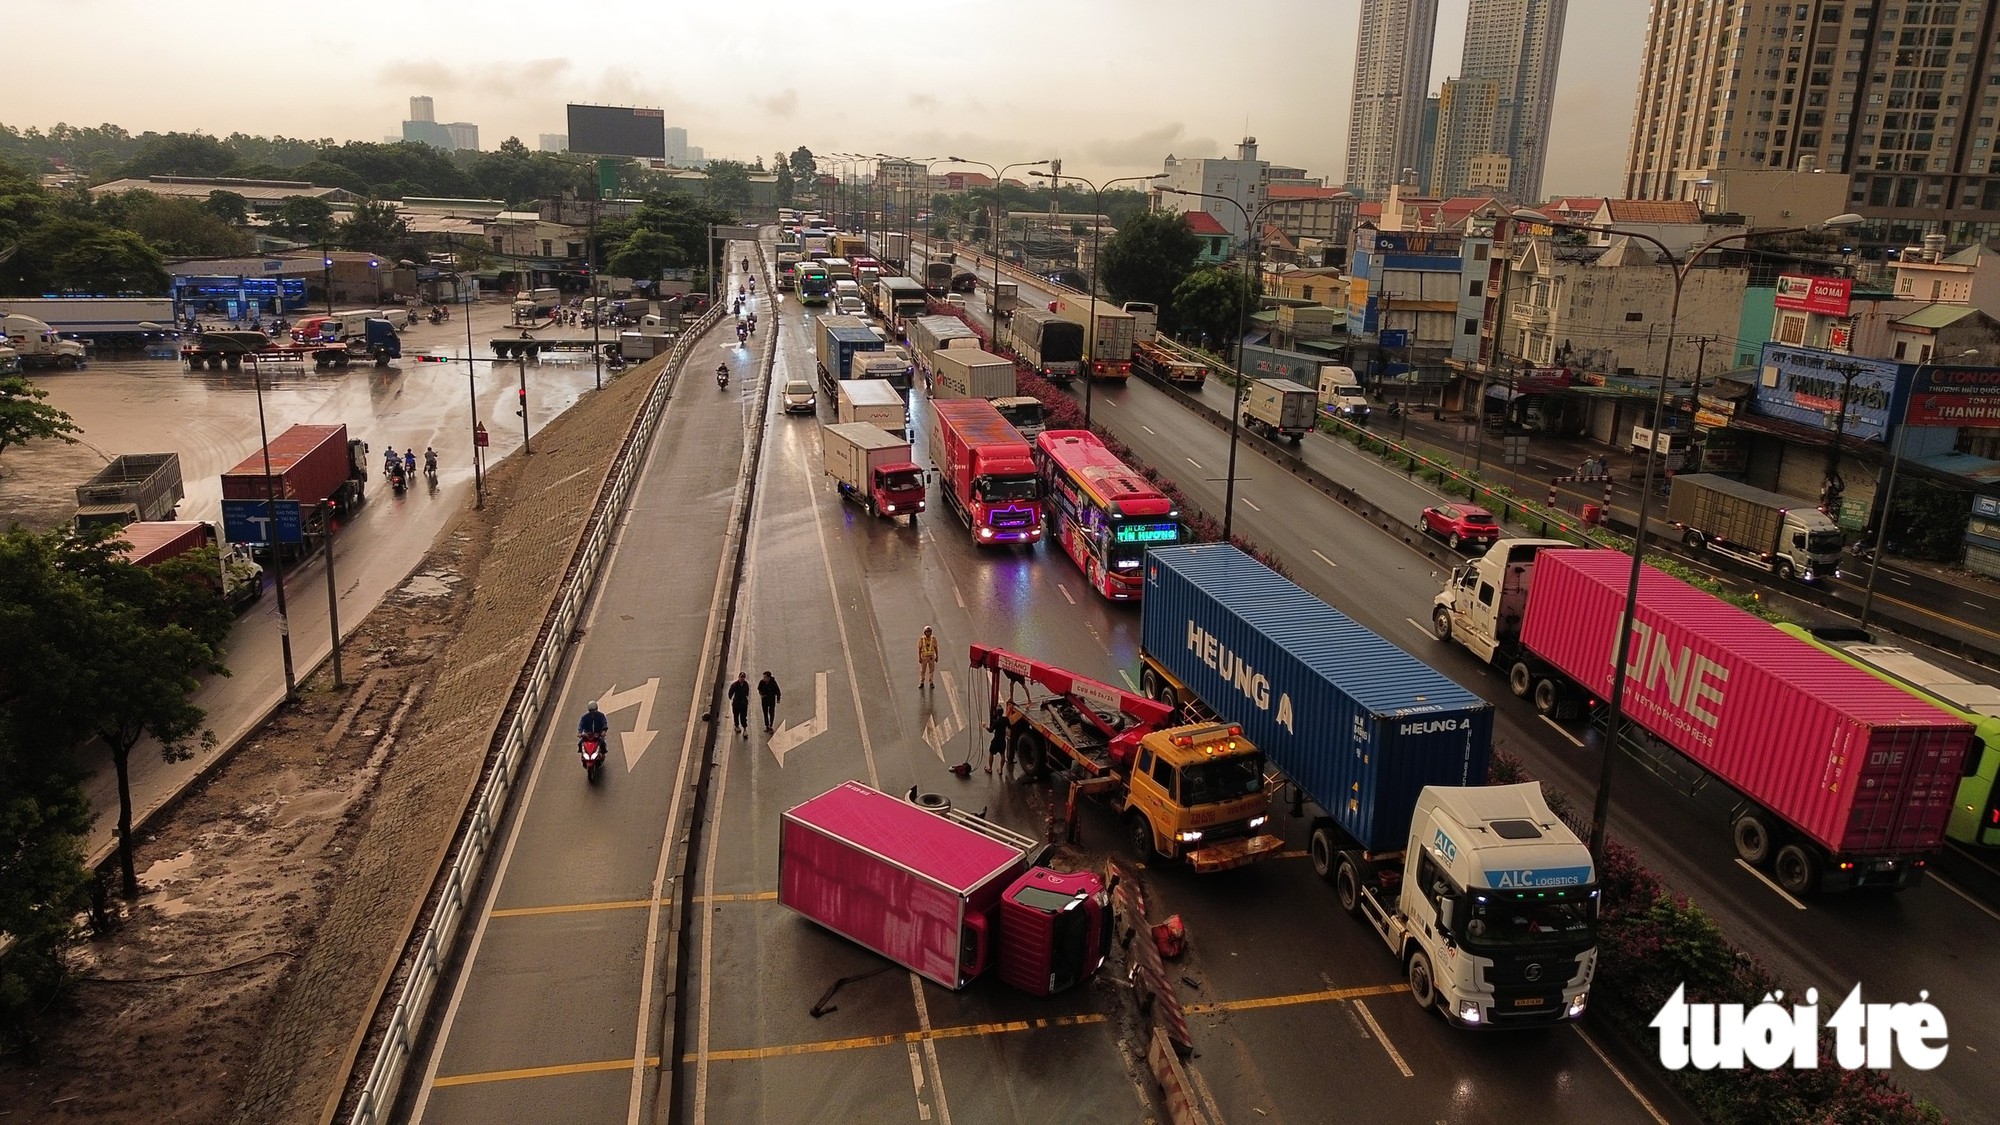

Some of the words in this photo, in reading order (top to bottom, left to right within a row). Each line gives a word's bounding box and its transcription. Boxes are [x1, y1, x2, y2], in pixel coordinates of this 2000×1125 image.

[1405, 237, 1428, 251] VMI
[1814, 286, 1828, 295] SAO
[1829, 288, 1843, 297] MAI
[1937, 406, 1984, 418] THANH
[1187, 619, 1270, 710] HEUNG
[1276, 693, 1294, 735] A
[1610, 611, 1729, 730] ONE
[1400, 719, 1457, 735] HEUNG
[1460, 718, 1471, 730] A
[1635, 693, 1673, 722] NETWORK
[1675, 717, 1714, 748] EXPRESS
[1870, 751, 1904, 765] ONE
[1435, 833, 1456, 860] ALC
[1499, 870, 1534, 888] ALC
[1536, 876, 1579, 887] LOGISTICS
